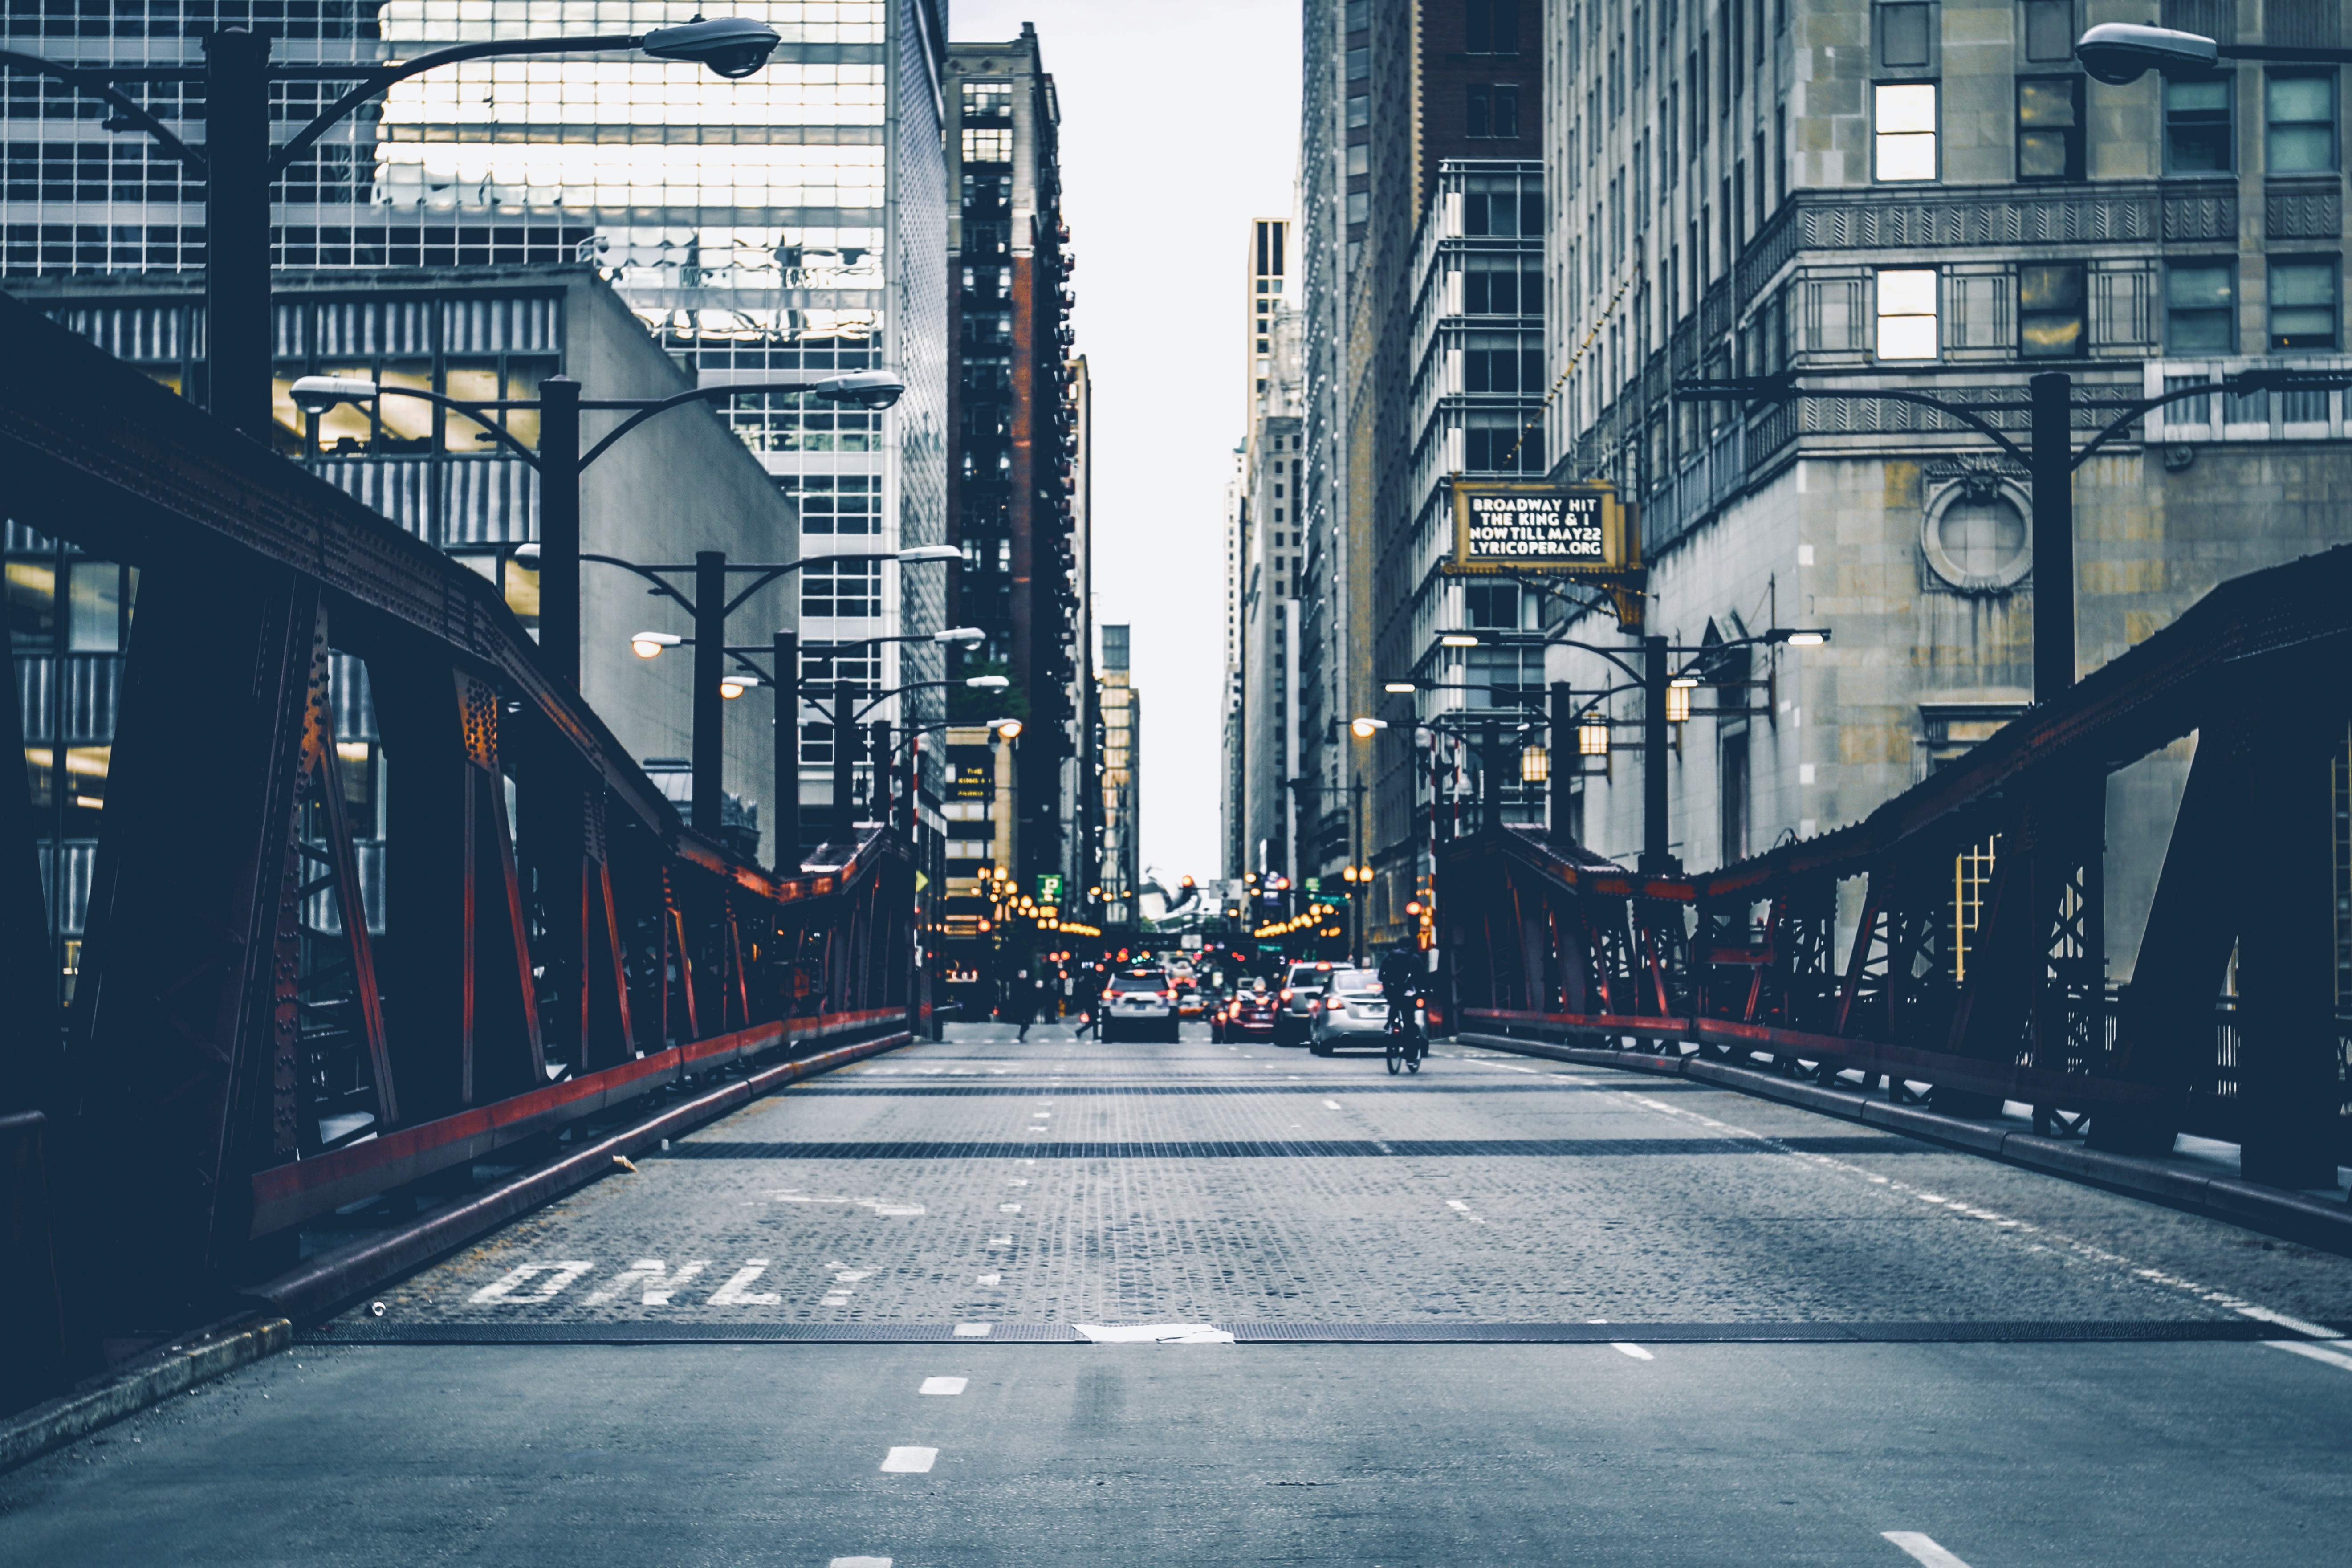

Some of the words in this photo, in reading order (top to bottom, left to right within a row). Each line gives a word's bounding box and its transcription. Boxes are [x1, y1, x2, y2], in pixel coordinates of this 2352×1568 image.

[1473, 498, 1562, 512] BROADWAY
[1568, 499, 1597, 512] HIT
[1480, 513, 1513, 525] THE
[1518, 513, 1559, 526] KING
[1564, 513, 1578, 526] &
[1583, 513, 1589, 525] I
[1469, 527, 1508, 540] NOW
[1510, 527, 1546, 540] TILL
[1469, 541, 1601, 555] LYRICOPERA.ORG
[467, 1259, 884, 1306] ONLY
